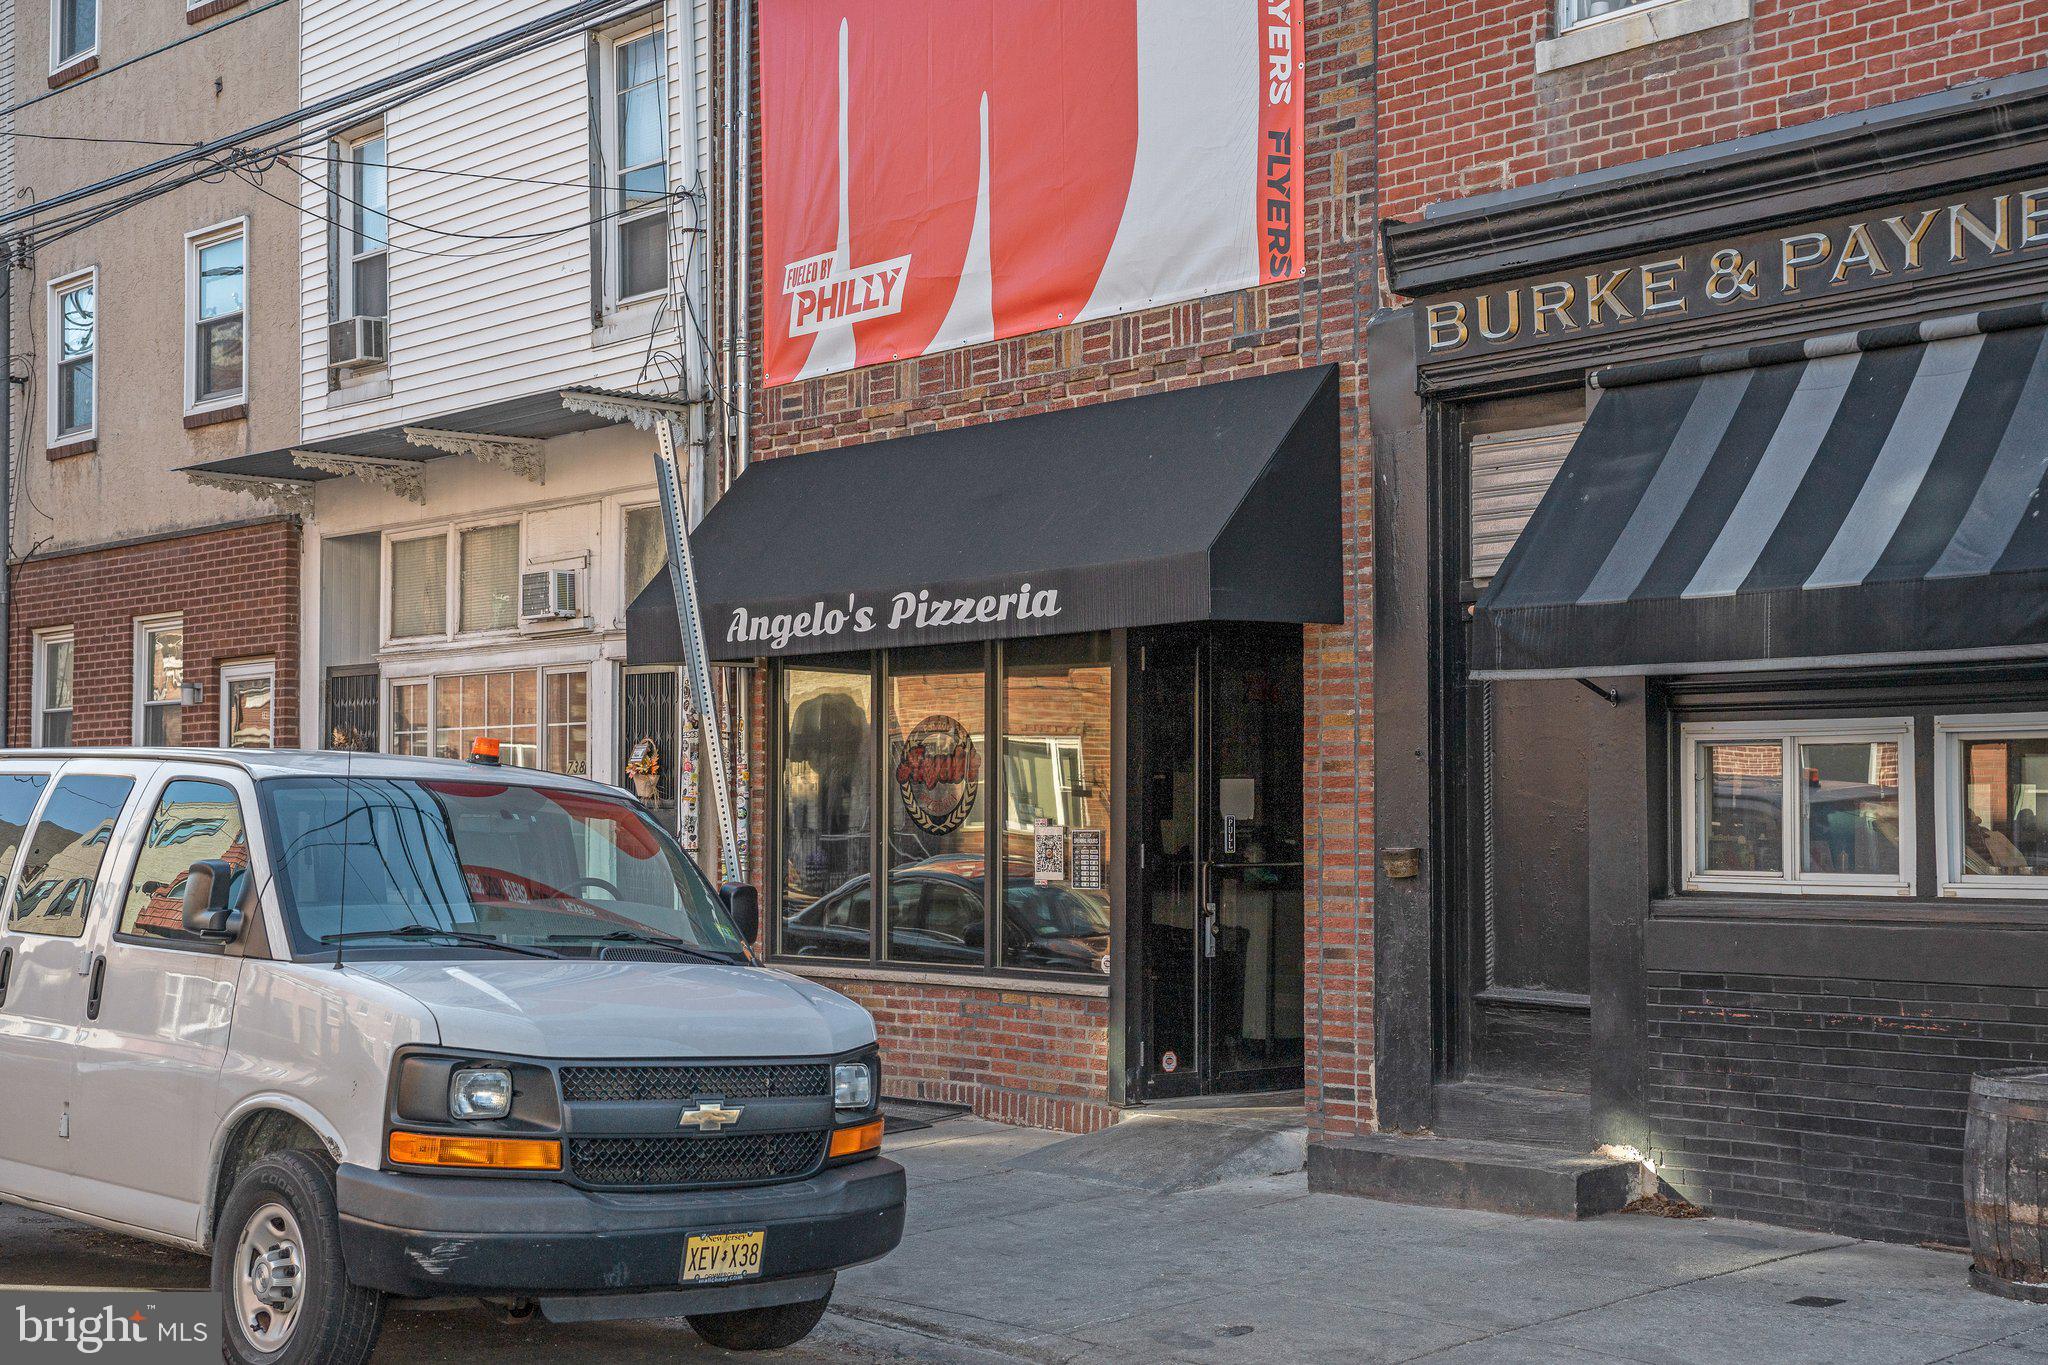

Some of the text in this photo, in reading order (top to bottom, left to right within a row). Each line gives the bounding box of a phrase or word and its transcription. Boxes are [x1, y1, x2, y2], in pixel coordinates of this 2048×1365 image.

[1266, 0, 1292, 280] YERS FLYERS
[787, 257, 834, 290] FUELED BY
[1425, 187, 2048, 352] BURKE & PAYNE
[796, 266, 903, 327] PHILLY
[726, 582, 1062, 649] Angelo's Pizzeria
[567, 760, 586, 774] 738
[688, 1242, 759, 1271] XEV X38
[706, 1233, 747, 1243] New Jersey
